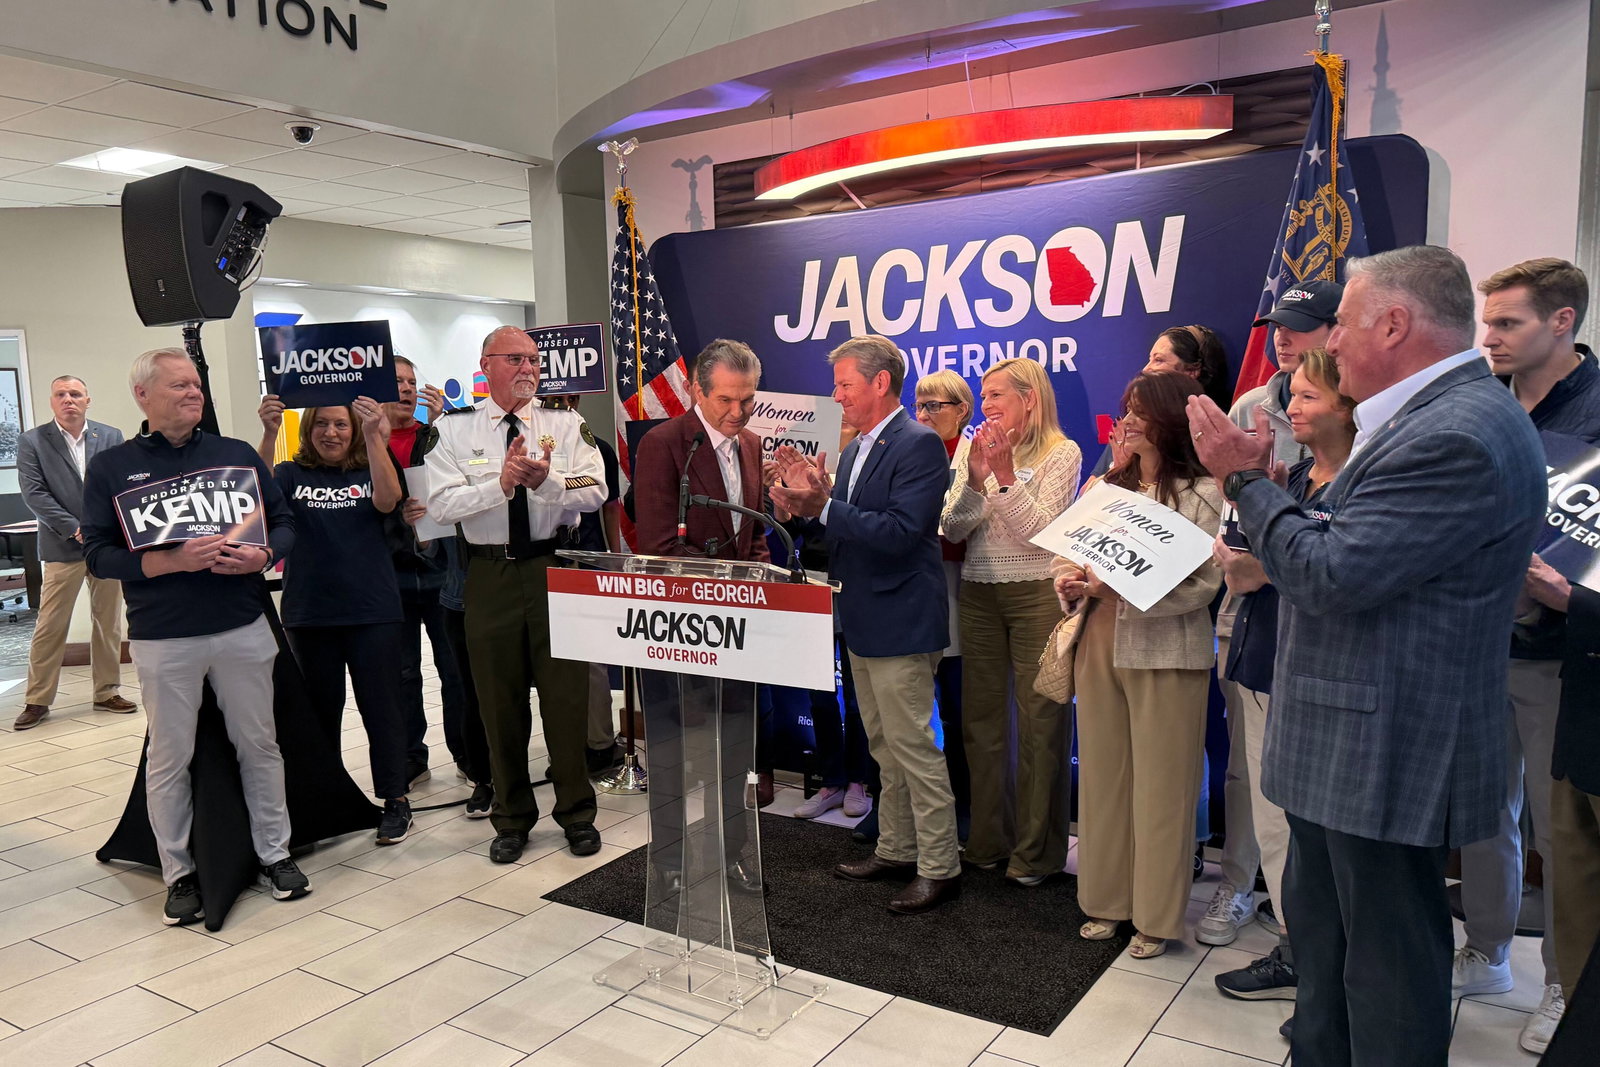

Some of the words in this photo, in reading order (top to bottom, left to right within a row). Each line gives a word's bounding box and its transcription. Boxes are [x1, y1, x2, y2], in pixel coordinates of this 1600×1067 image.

[774, 215, 1185, 343] JACKSON
[537, 337, 569, 348] ORSED
[573, 337, 585, 346] BY
[271, 345, 383, 374] JACKSON
[538, 347, 598, 379] EMP
[300, 372, 363, 385] GOVERNOR
[750, 401, 816, 423] Women
[774, 424, 787, 435] for
[141, 481, 214, 503] ENDORSED
[222, 480, 236, 489] BY
[292, 481, 372, 502] JACKSON
[307, 500, 357, 509] GOVERNOR
[1546, 465, 1600, 531] ACK
[130, 491, 256, 533] KEMP
[1102, 499, 1175, 544] Women
[187, 524, 221, 533] JACKSON
[1110, 525, 1129, 537] for
[1545, 506, 1600, 549] OVER
[1064, 526, 1153, 577] JACKSON
[1071, 544, 1116, 573] GOVERNOR
[596, 575, 632, 595] WIN
[634, 578, 666, 597] BIG
[669, 583, 689, 598] for
[692, 582, 768, 605] GEORGIA
[616, 608, 746, 650] JACKSON
[647, 646, 718, 666] GOVERNOR
